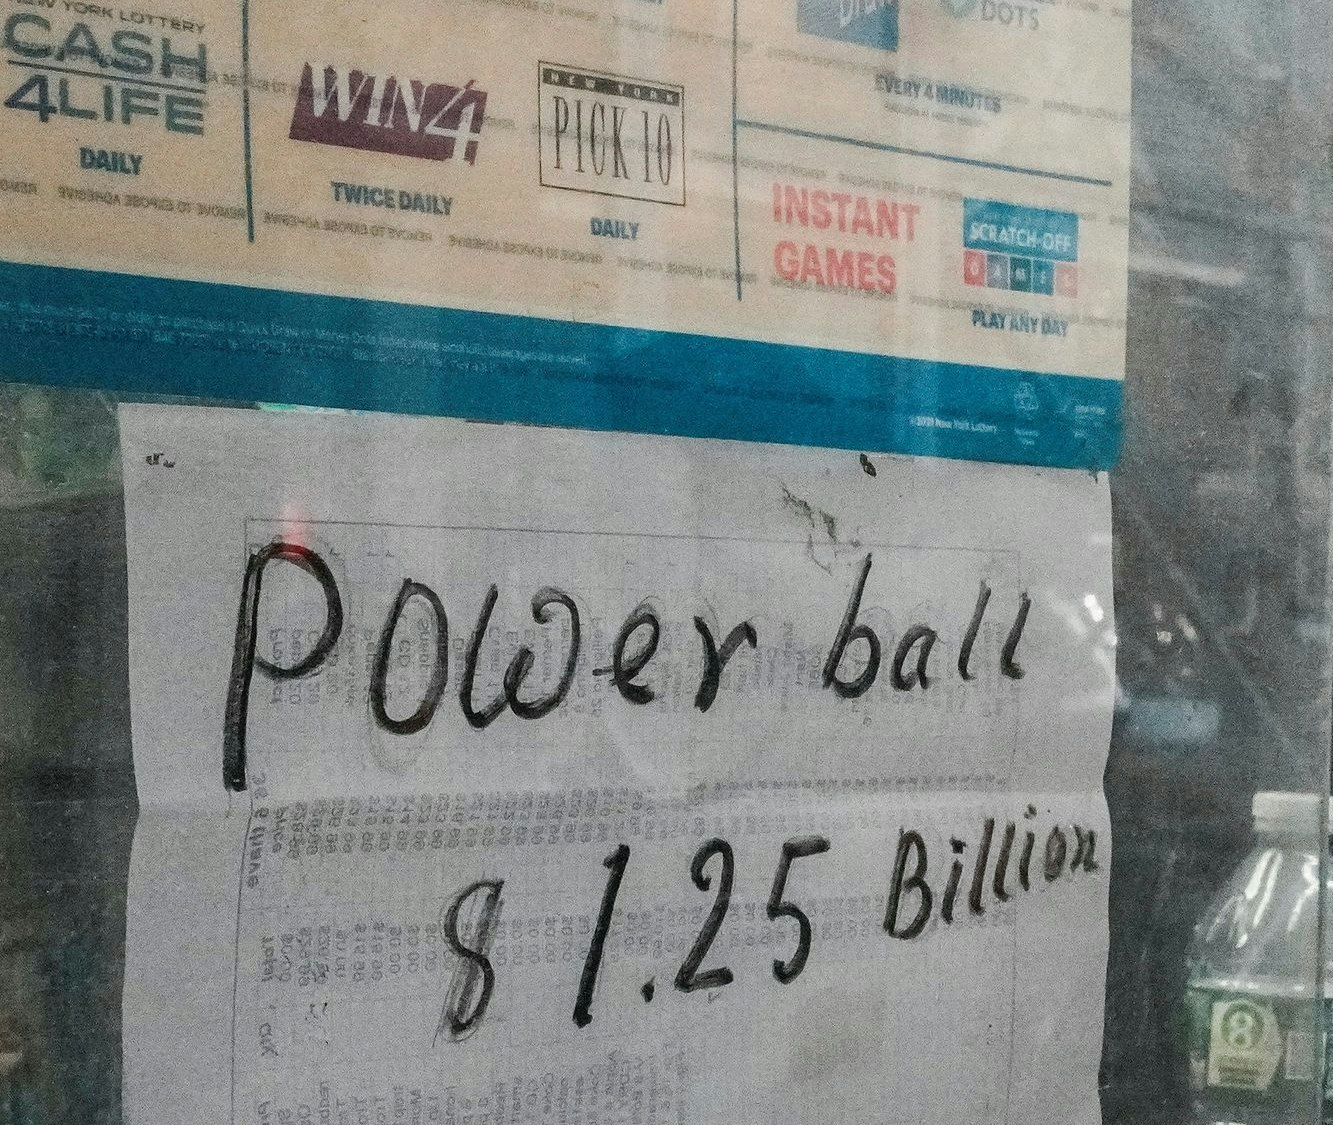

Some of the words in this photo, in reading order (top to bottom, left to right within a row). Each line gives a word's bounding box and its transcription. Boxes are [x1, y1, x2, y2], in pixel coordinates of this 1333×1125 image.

[65, 1, 114, 20] YORK
[119, 10, 207, 34] LOTTERY
[981, 1, 1040, 31] DOTS
[4, 13, 208, 84] CASH
[549, 72, 598, 90] NEW
[615, 84, 676, 104] YORK
[875, 71, 921, 99] EVERY
[4, 74, 205, 137] 4LIFE
[305, 61, 483, 167] WIN4
[553, 95, 630, 180] PICK
[641, 110, 672, 186] 10
[79, 146, 143, 176] DAILY
[331, 180, 396, 209] TWICE
[400, 190, 453, 216] DAILY
[773, 182, 921, 243] INSTANT
[590, 215, 640, 241] DAILY
[968, 222, 1073, 254] SCRATCH-OFF
[773, 240, 898, 295] GAMES
[972, 309, 1004, 331] PLAY
[1009, 312, 1038, 333] ANY
[1041, 317, 1068, 338] DAY
[820, 553, 1034, 698] ball
[883, 805, 1099, 942] Billion
